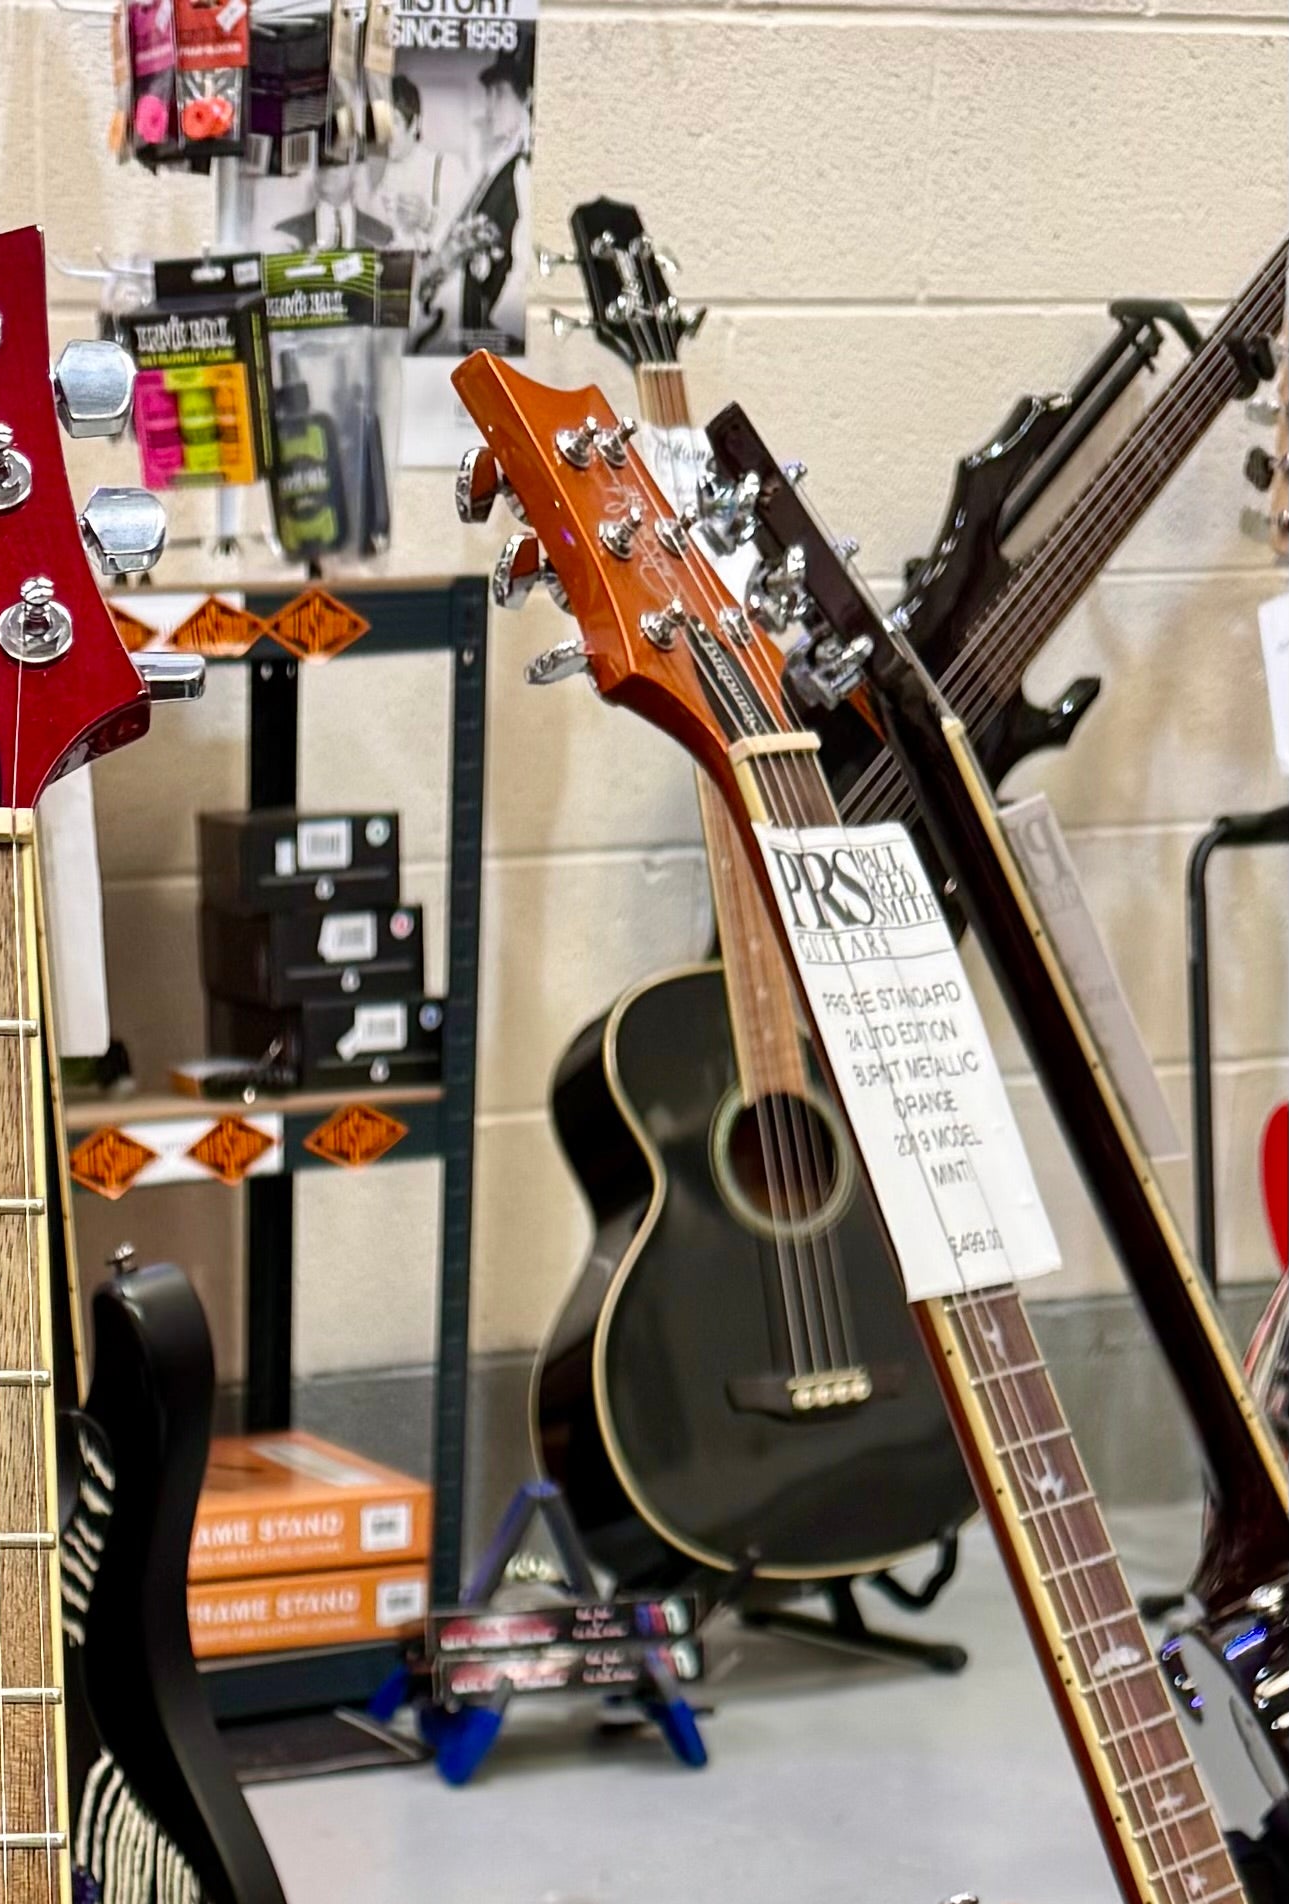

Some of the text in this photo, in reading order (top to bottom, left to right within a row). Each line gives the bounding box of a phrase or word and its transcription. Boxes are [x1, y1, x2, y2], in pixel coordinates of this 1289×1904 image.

[389, 16, 518, 50] SINCE 1958
[771, 847, 875, 929] PRS
[873, 893, 939, 925] SMITH
[797, 931, 891, 961] GUITARS
[876, 981, 961, 1010] STANDARD
[905, 1051, 979, 1079] METALLIC
